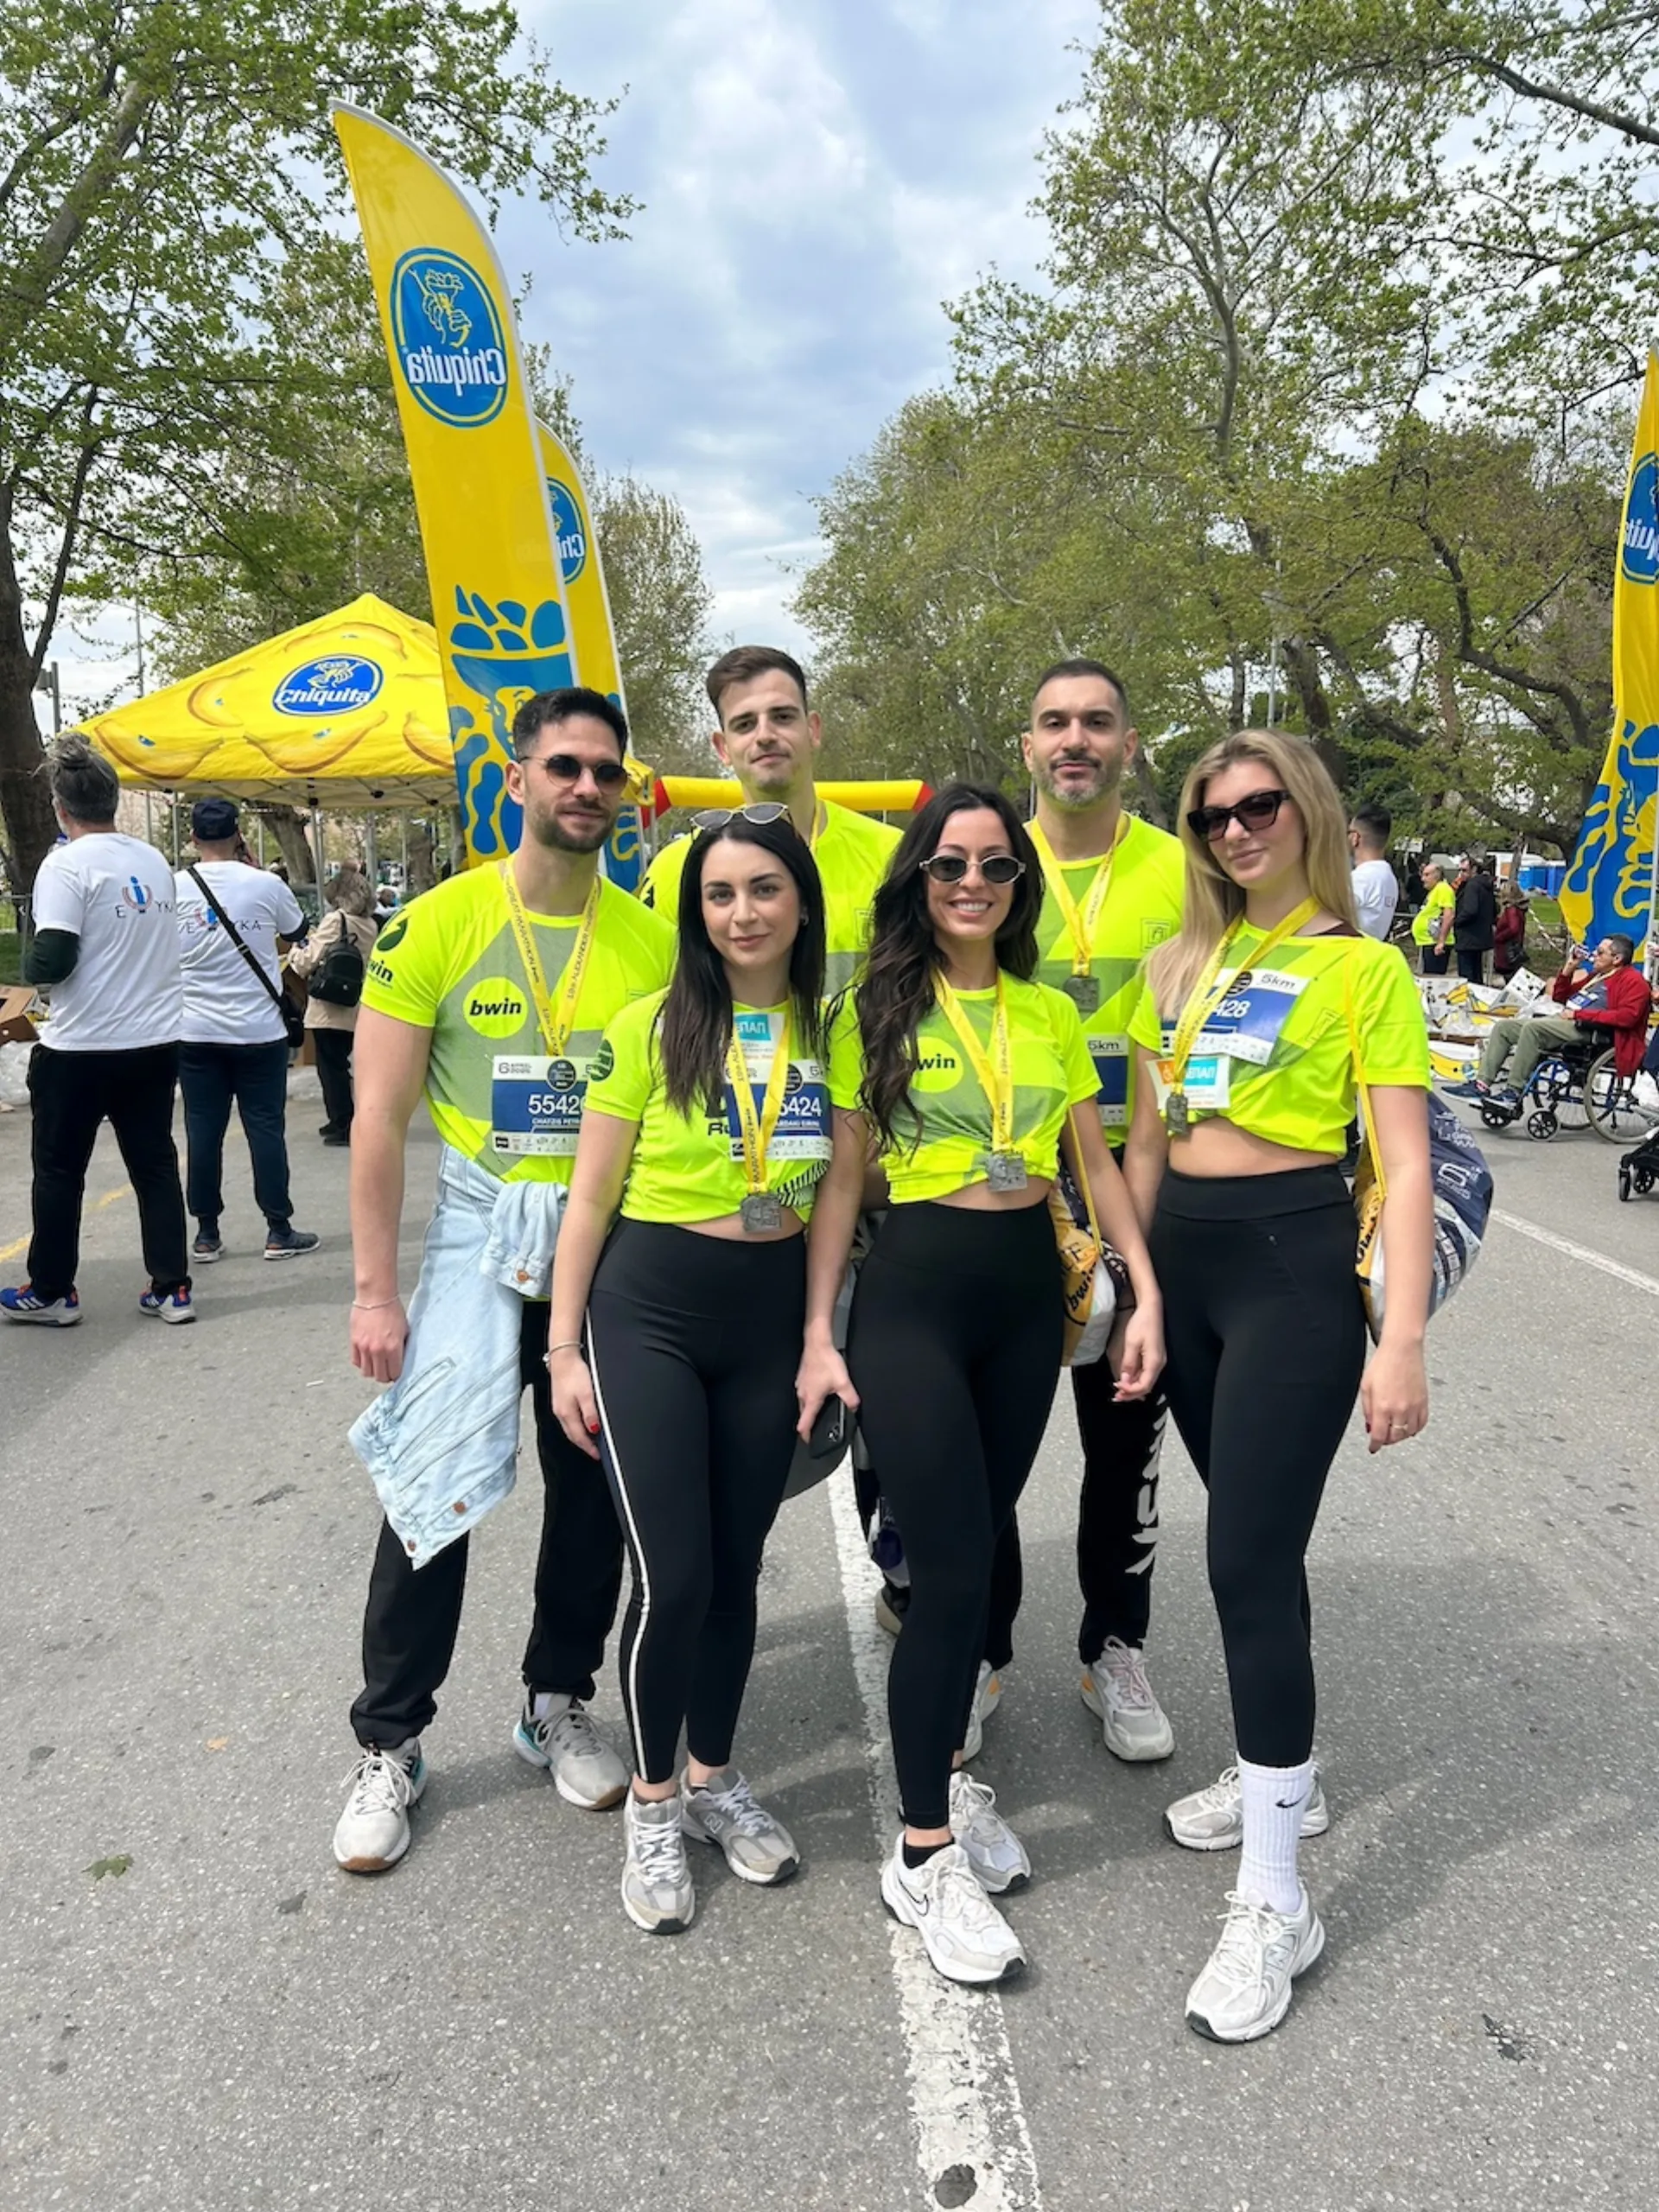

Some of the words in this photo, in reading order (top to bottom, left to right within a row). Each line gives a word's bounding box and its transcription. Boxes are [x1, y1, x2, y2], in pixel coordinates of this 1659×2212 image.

[274, 687, 372, 706] Chiquita
[1262, 974, 1296, 988] 5km
[469, 997, 522, 1016] bwin
[1215, 999, 1251, 1018] 428
[1088, 1040, 1119, 1050] 5km
[499, 1062, 510, 1074] 6
[918, 1053, 956, 1070] win
